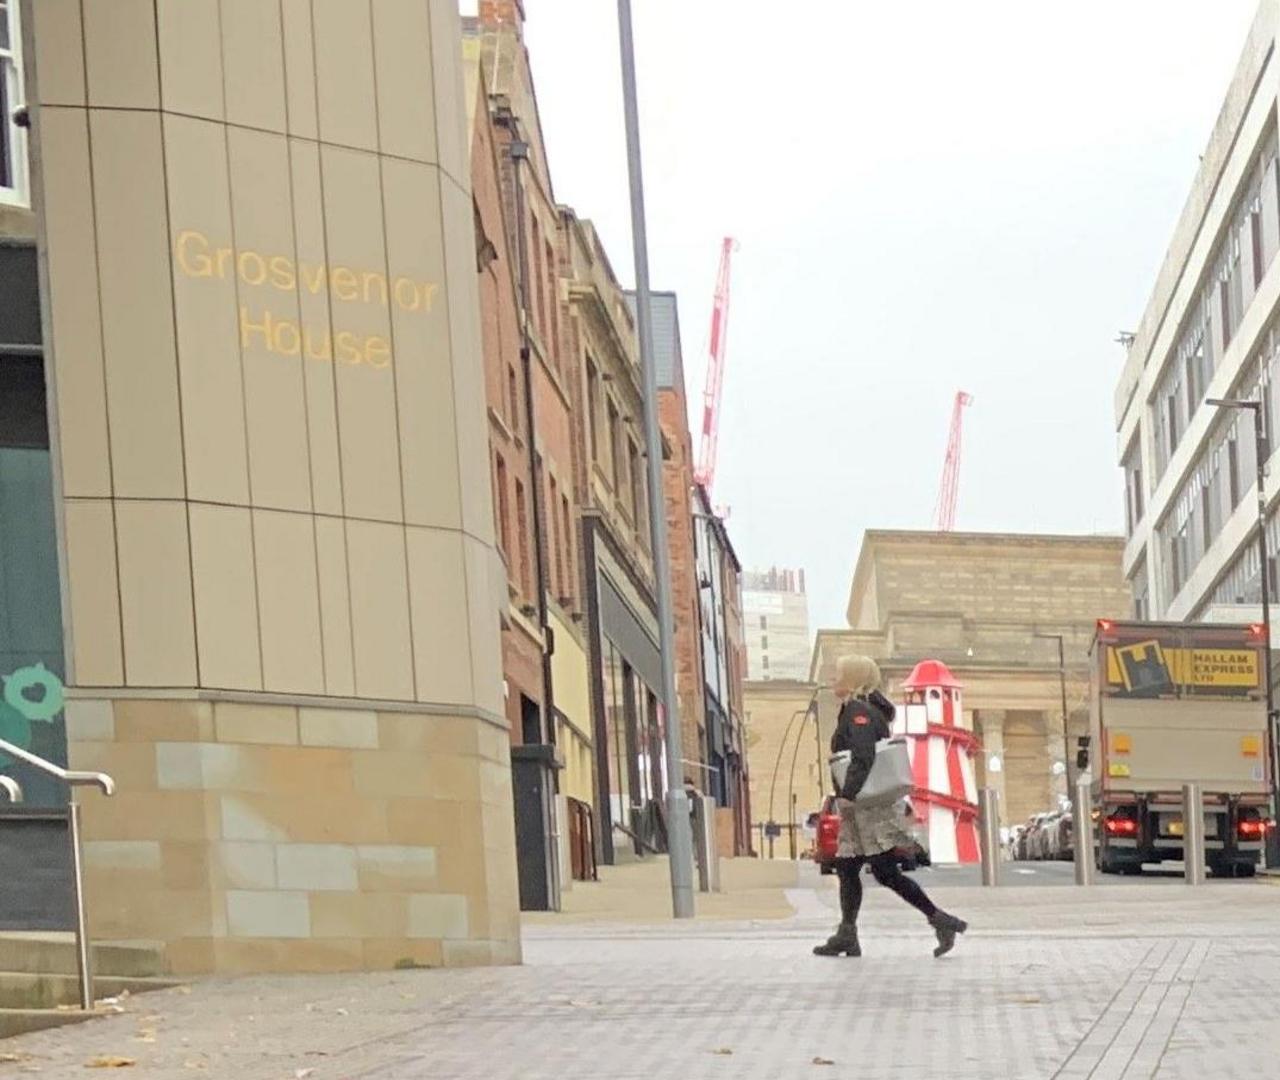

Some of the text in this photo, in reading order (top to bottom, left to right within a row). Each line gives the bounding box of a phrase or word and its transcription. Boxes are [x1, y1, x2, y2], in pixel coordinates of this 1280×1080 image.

[175, 230, 439, 312] Grosvenor
[240, 305, 390, 369] House
[1194, 654, 1248, 663] HALLAM
[1194, 665, 1254, 674] EXPRESS
